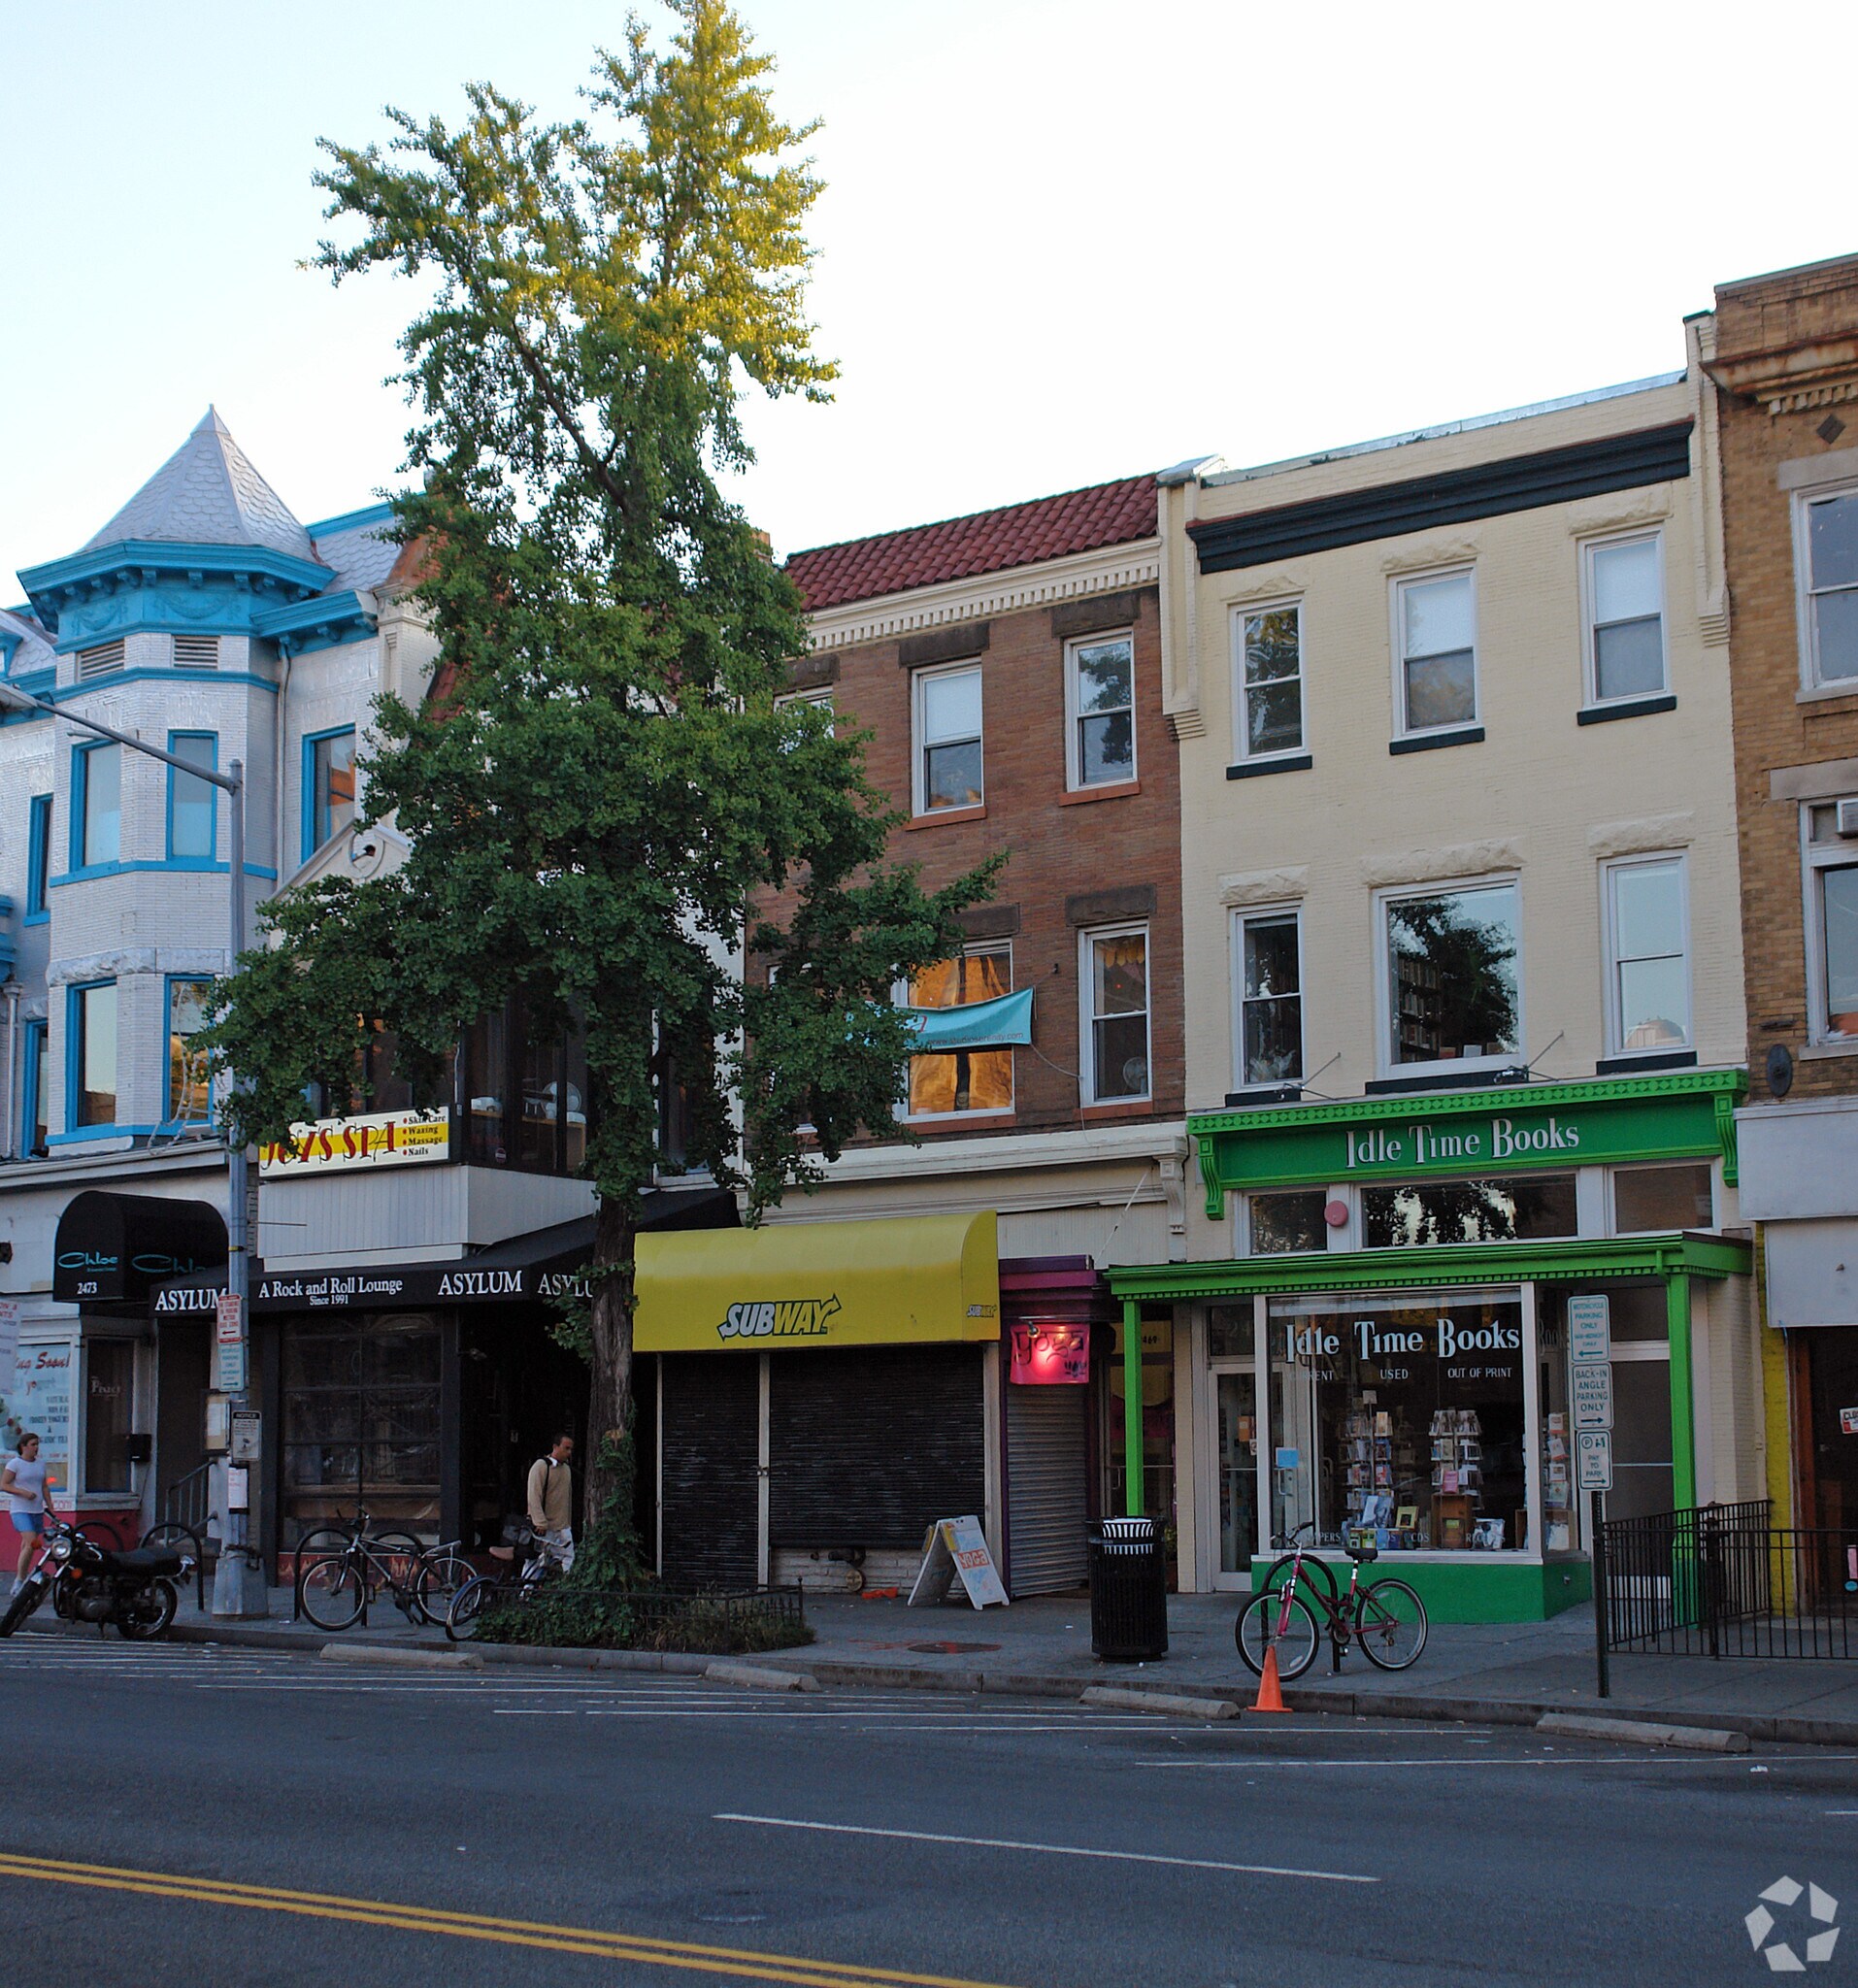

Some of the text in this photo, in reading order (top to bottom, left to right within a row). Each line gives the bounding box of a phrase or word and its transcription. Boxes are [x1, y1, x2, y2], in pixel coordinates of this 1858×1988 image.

[428, 1115, 446, 1124] Care
[409, 1126, 438, 1135] Waxing
[343, 1121, 396, 1162] SPA
[409, 1136, 443, 1145] Massage
[1346, 1117, 1579, 1169] Idle Time Books
[409, 1147, 429, 1156] Nails
[57, 1251, 118, 1269] Chloe
[132, 1253, 207, 1274] Chlo
[77, 1282, 98, 1295] 2473
[258, 1276, 403, 1298] A Rock and Roll Lounge
[437, 1271, 523, 1296] ASYLUM
[537, 1273, 594, 1298] ASYLU
[154, 1288, 228, 1311] ASYLUM
[309, 1294, 348, 1306] Since 1991
[719, 1296, 839, 1340] SUBWAY
[1286, 1318, 1520, 1363] Idle Time Books
[1379, 1369, 1409, 1379] USED
[1447, 1367, 1512, 1378] OUT OF PRINT
[1576, 1369, 1608, 1379] BACK-IN
[1576, 1392, 1609, 1401] PARKING
[1580, 1403, 1605, 1412] ONLY
